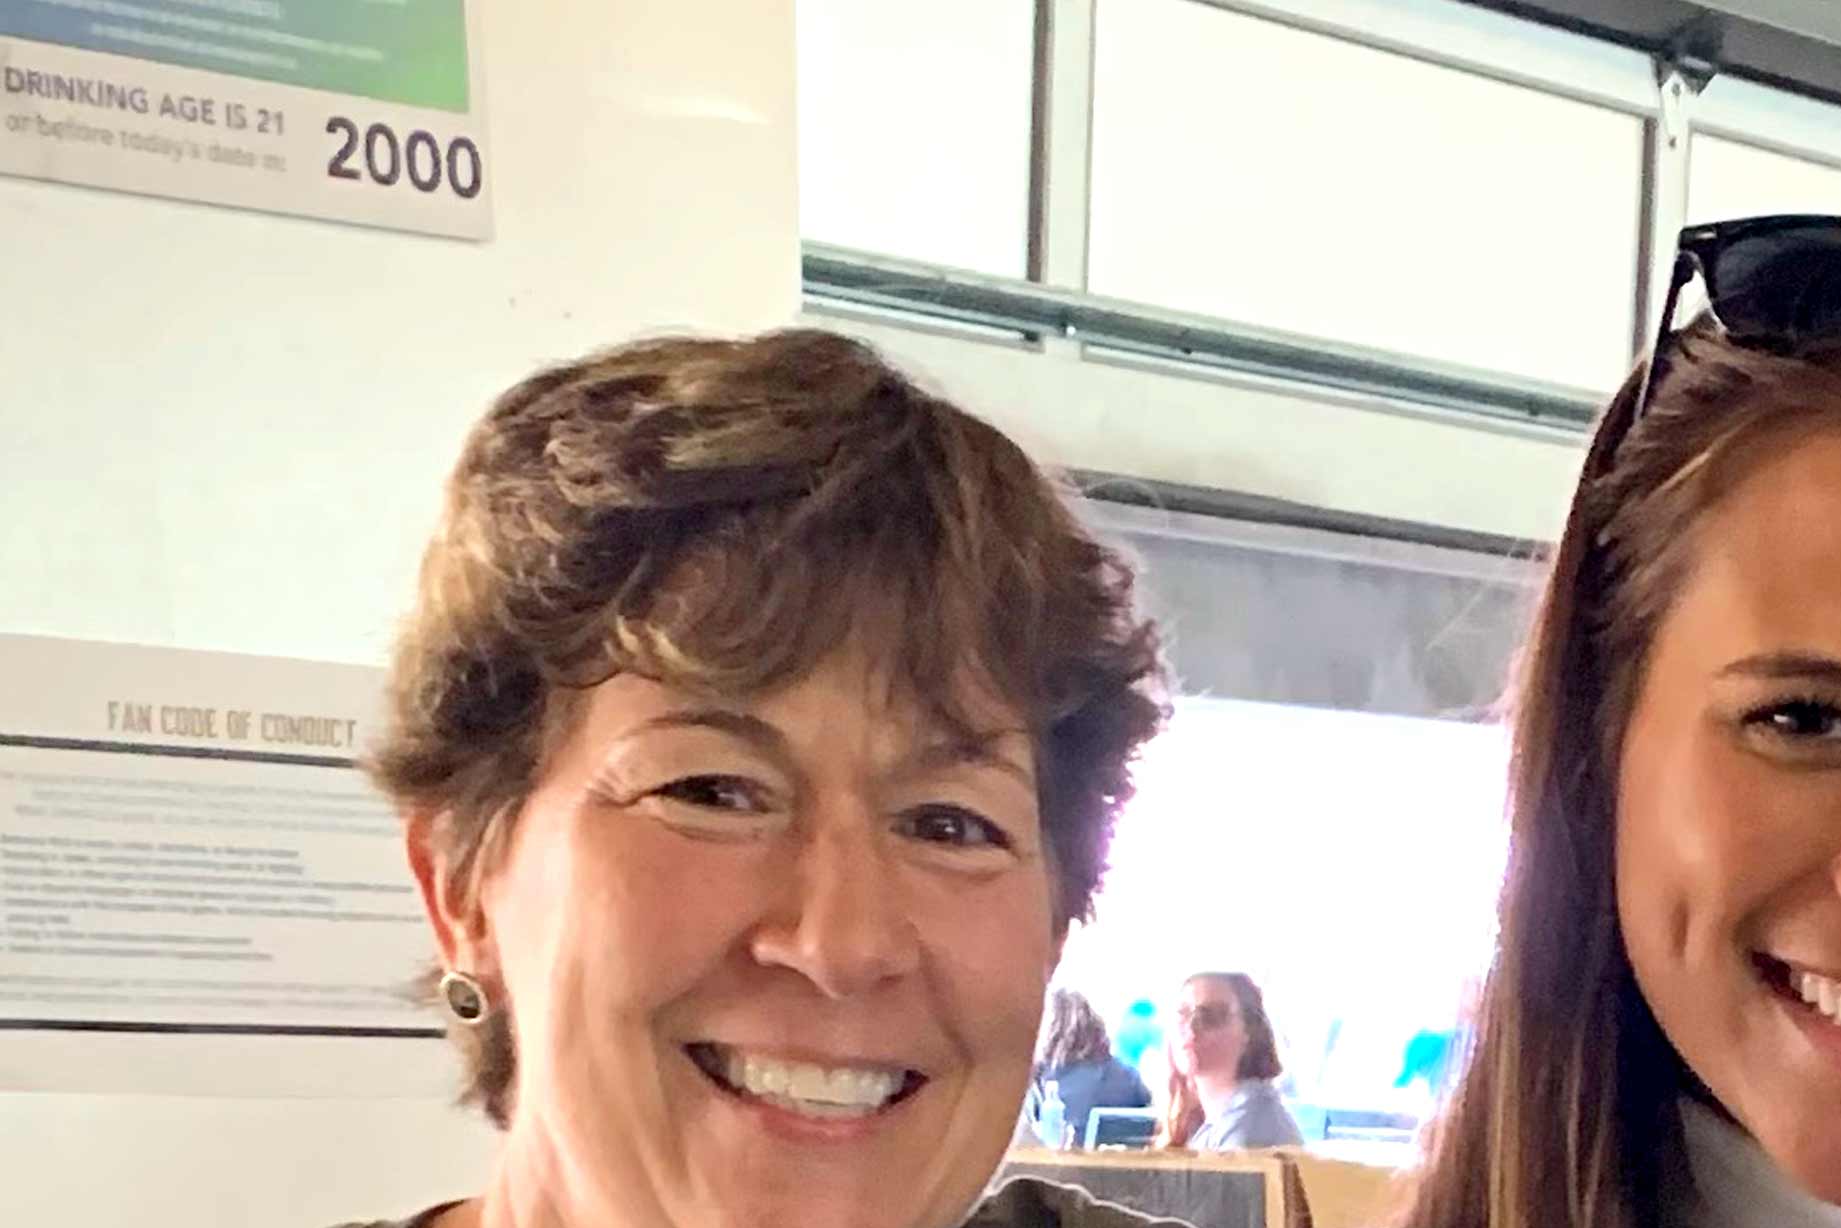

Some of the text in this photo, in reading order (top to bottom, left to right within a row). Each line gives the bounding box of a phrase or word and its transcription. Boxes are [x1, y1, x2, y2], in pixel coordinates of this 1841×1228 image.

[4, 66, 285, 135] DRINKING AGE IS 21
[326, 115, 483, 200] 2000
[107, 701, 357, 749] FAN CODE OF CONDUCT
